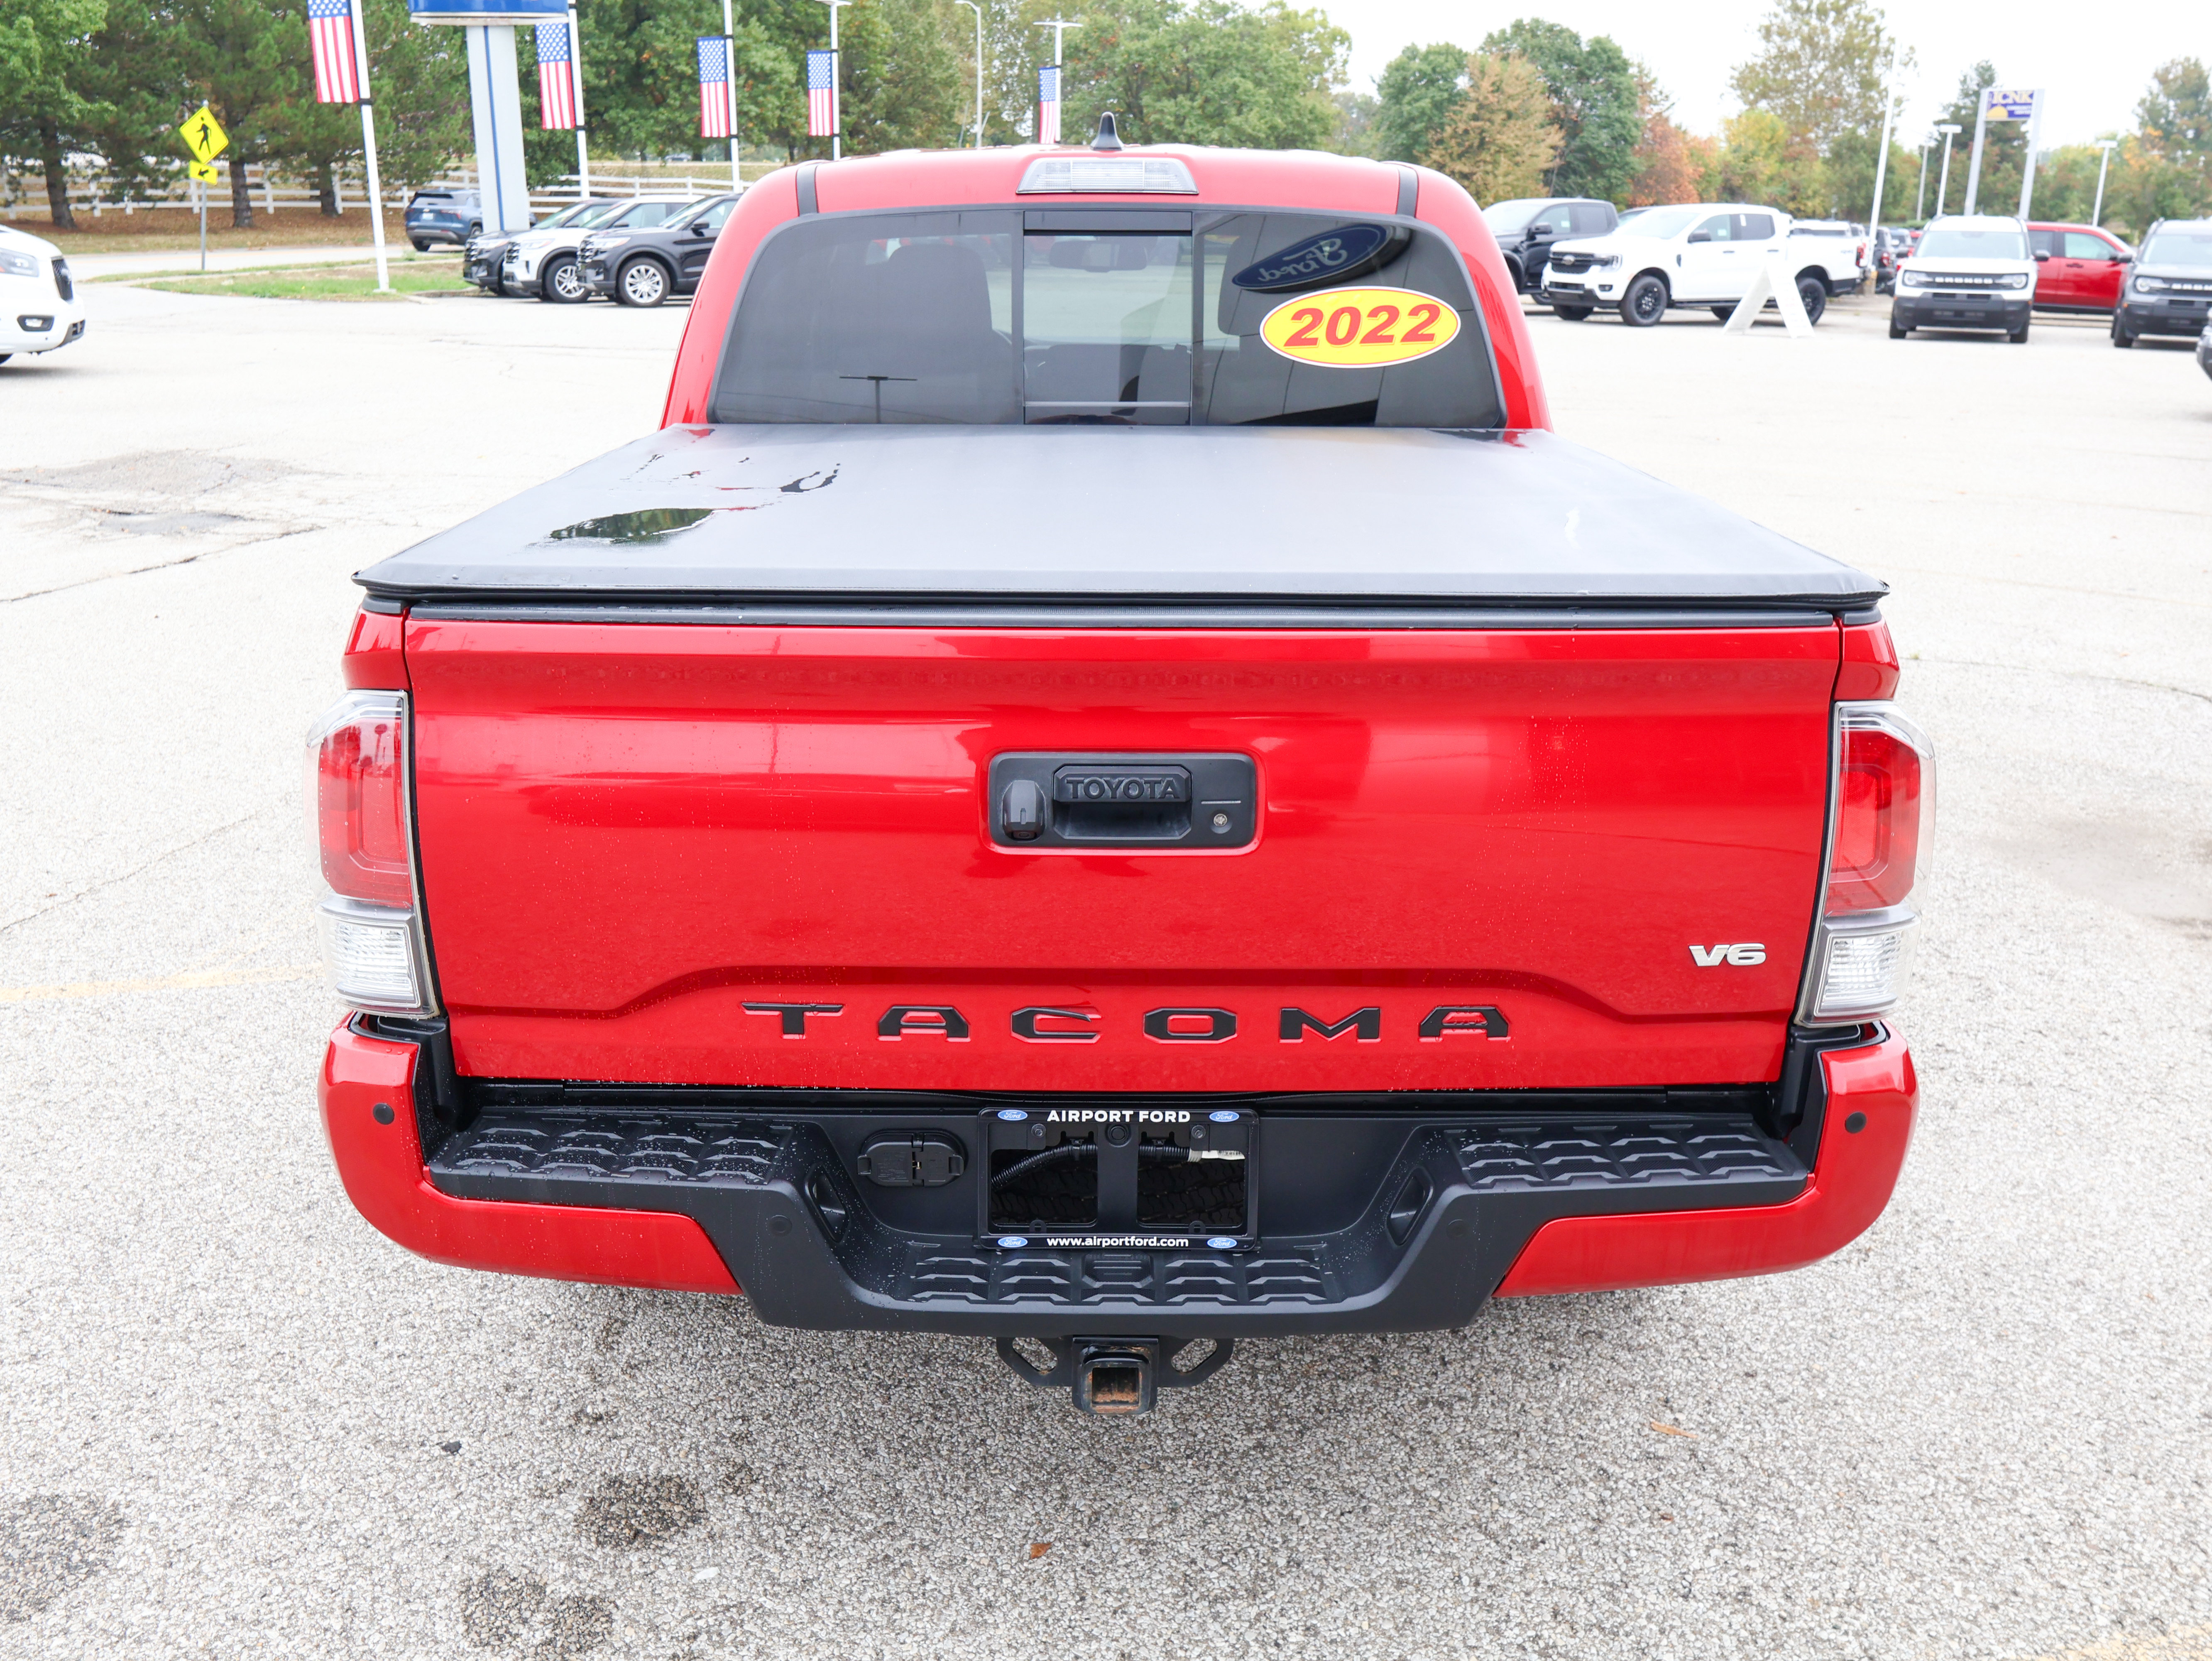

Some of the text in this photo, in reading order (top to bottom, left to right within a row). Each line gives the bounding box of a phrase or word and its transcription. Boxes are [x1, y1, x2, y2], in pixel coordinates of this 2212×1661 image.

[1283, 304, 1441, 348] 2022
[1066, 778, 1179, 799] TOYOTA
[1689, 943, 1766, 967] V6
[742, 1002, 1509, 1040] TACOMA
[1047, 1110, 1190, 1122] AIRPORT FORD
[1047, 1236, 1189, 1247] www.airportford.com
